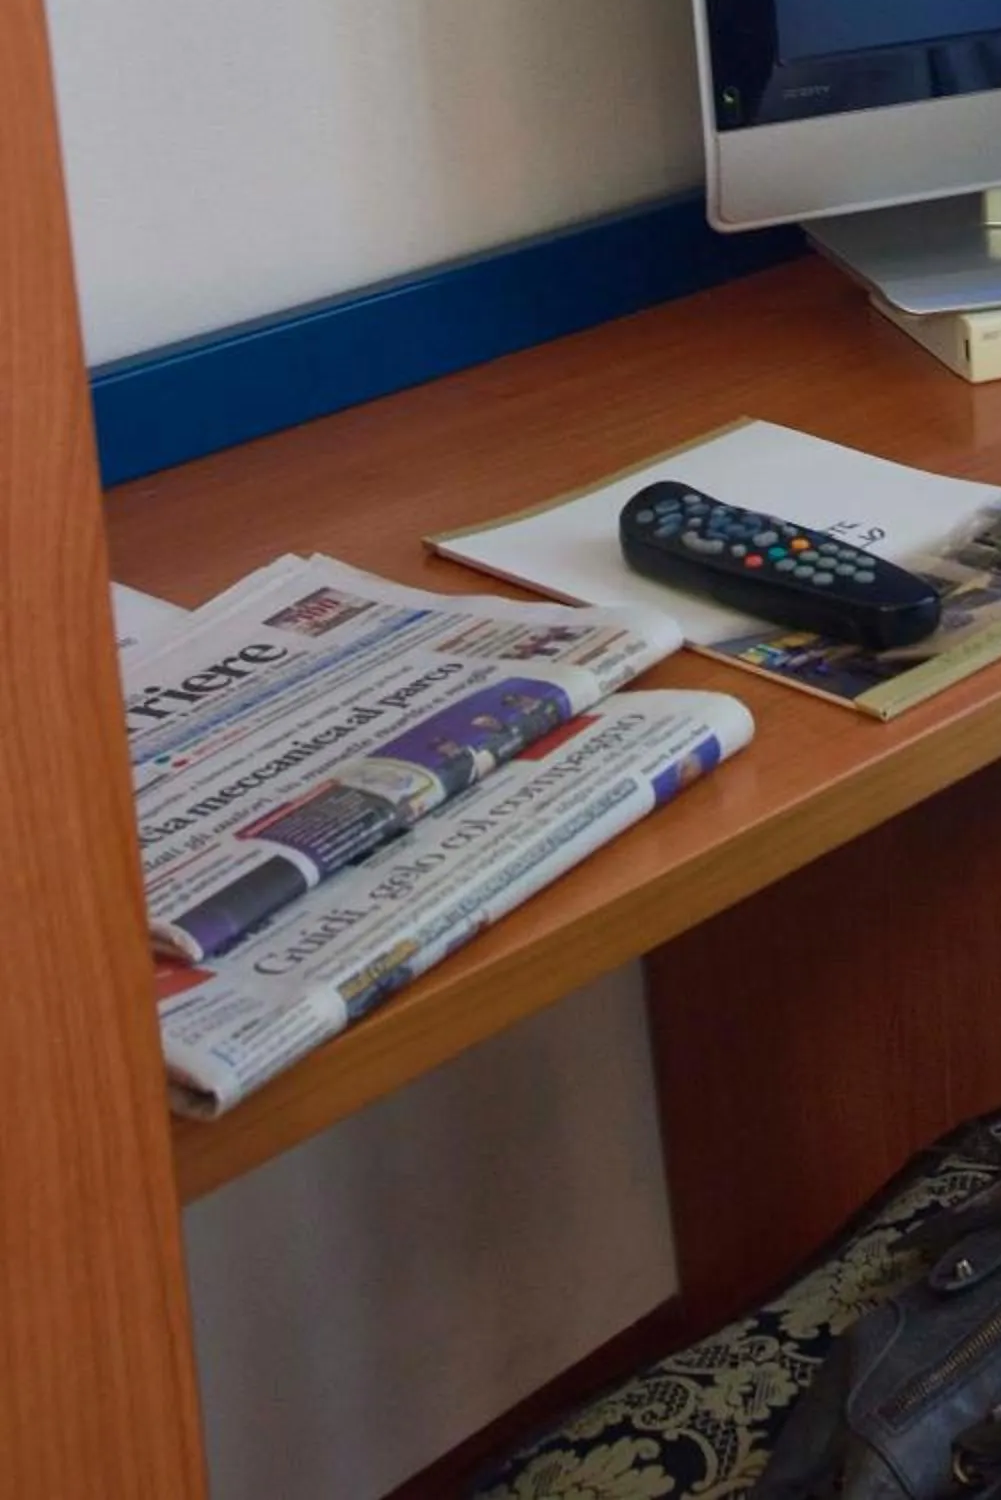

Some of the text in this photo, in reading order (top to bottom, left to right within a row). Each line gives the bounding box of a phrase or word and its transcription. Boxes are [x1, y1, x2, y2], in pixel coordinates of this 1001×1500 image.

[126, 643, 289, 734] riere
[186, 727, 358, 817] meccanica
[376, 663, 465, 709] parco
